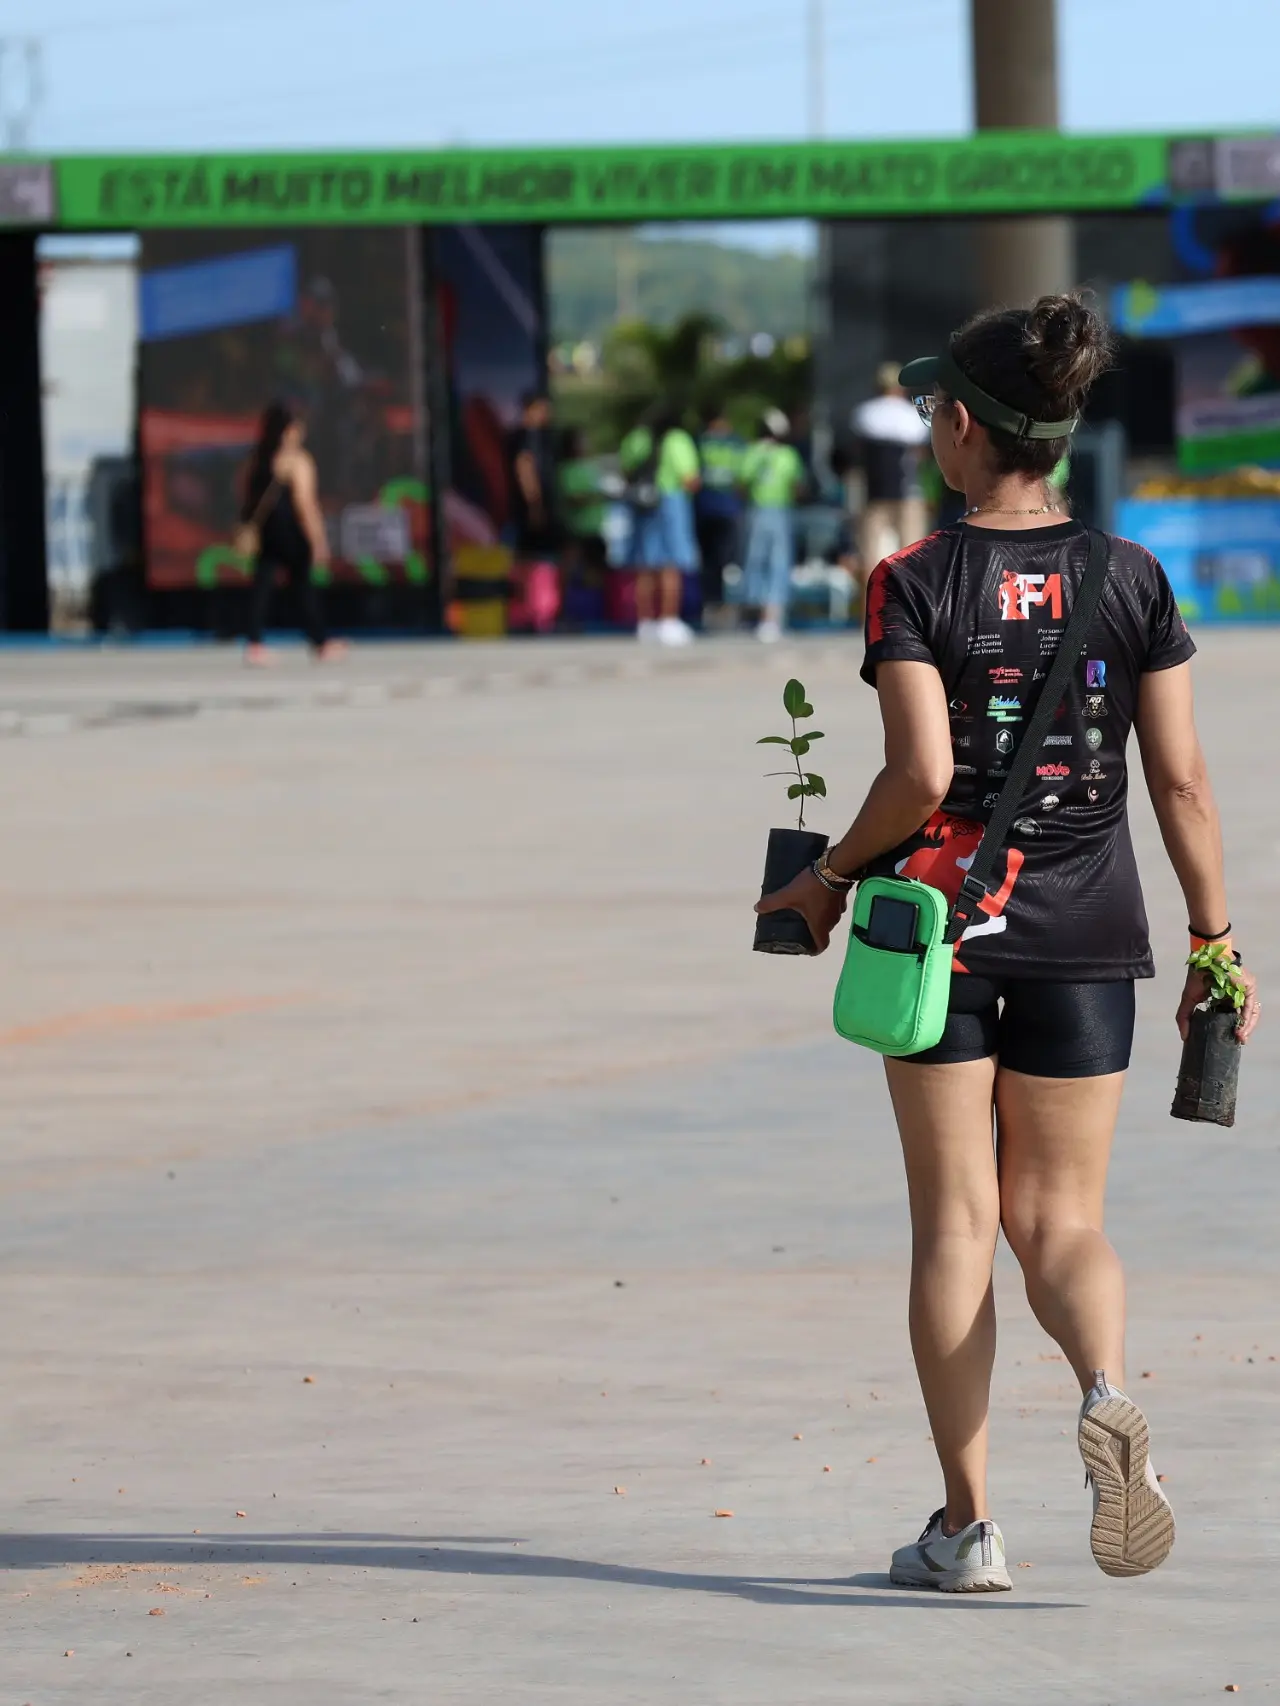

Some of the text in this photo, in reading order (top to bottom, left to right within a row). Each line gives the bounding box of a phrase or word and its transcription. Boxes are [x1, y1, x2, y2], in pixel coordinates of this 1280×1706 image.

[221, 165, 374, 210] MUITO
[385, 161, 575, 206] MELHOR
[584, 157, 716, 202] VIVER
[728, 155, 797, 198] EM
[806, 152, 938, 196] MATO
[945, 148, 1134, 194] GROSSO
